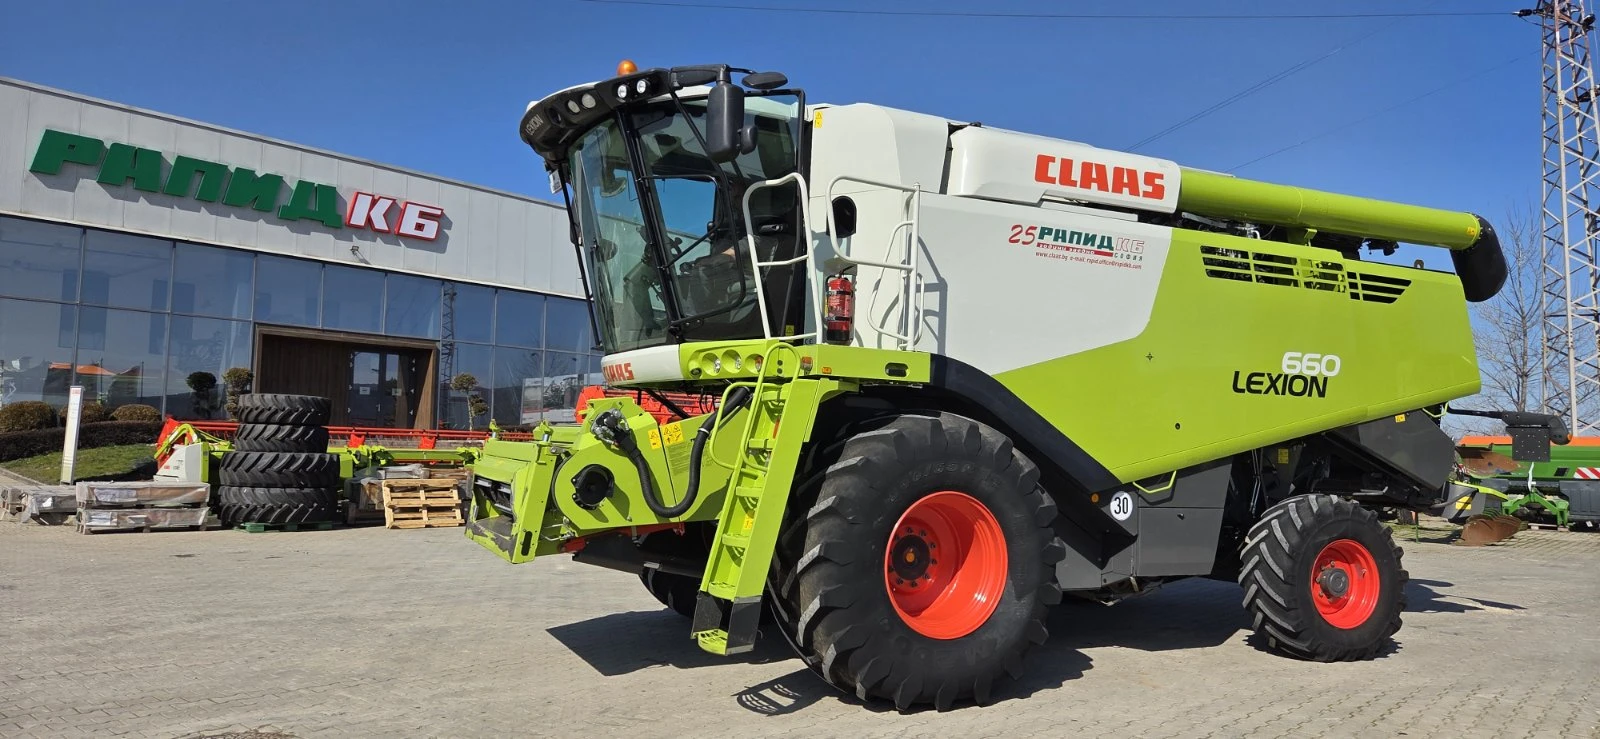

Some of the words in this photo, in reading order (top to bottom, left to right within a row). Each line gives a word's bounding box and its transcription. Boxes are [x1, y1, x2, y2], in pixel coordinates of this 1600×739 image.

[29, 128, 342, 228] РАПИД
[345, 190, 444, 241] КБ
[1034, 154, 1165, 200] CLAAS
[1008, 224, 1038, 245] 25
[1038, 226, 1114, 251] РАПИД
[1115, 237, 1145, 255] КБ
[1281, 351, 1341, 377] 660
[1232, 370, 1328, 398] LEXION
[1114, 496, 1129, 515] 30
